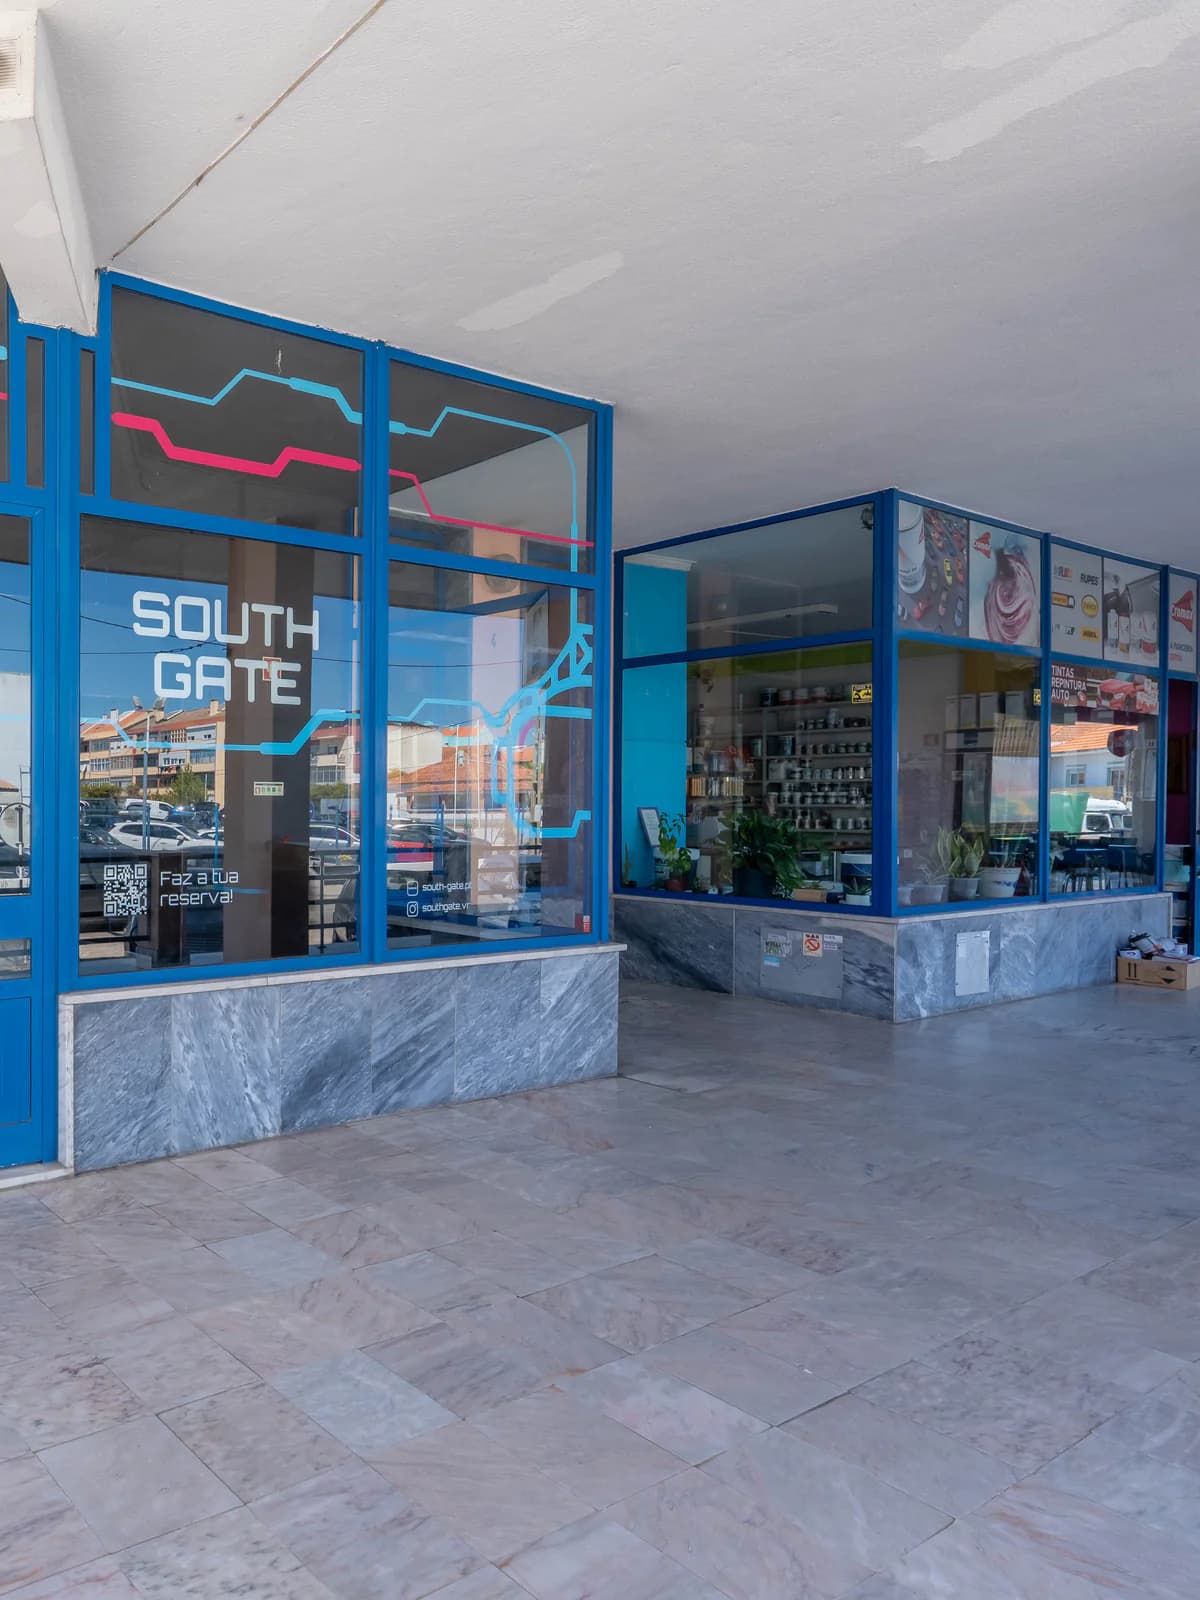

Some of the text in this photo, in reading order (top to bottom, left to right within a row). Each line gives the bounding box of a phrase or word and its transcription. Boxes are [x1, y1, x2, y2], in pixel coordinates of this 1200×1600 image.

[133, 590, 320, 651] SOUTH
[153, 653, 301, 705] GATE
[1051, 665, 1075, 678] TINTAS
[1051, 677, 1087, 691] REPINTURA
[1051, 689, 1070, 700] AUTO
[160, 870, 239, 887] Faz a tua
[160, 889, 233, 907] reserva!
